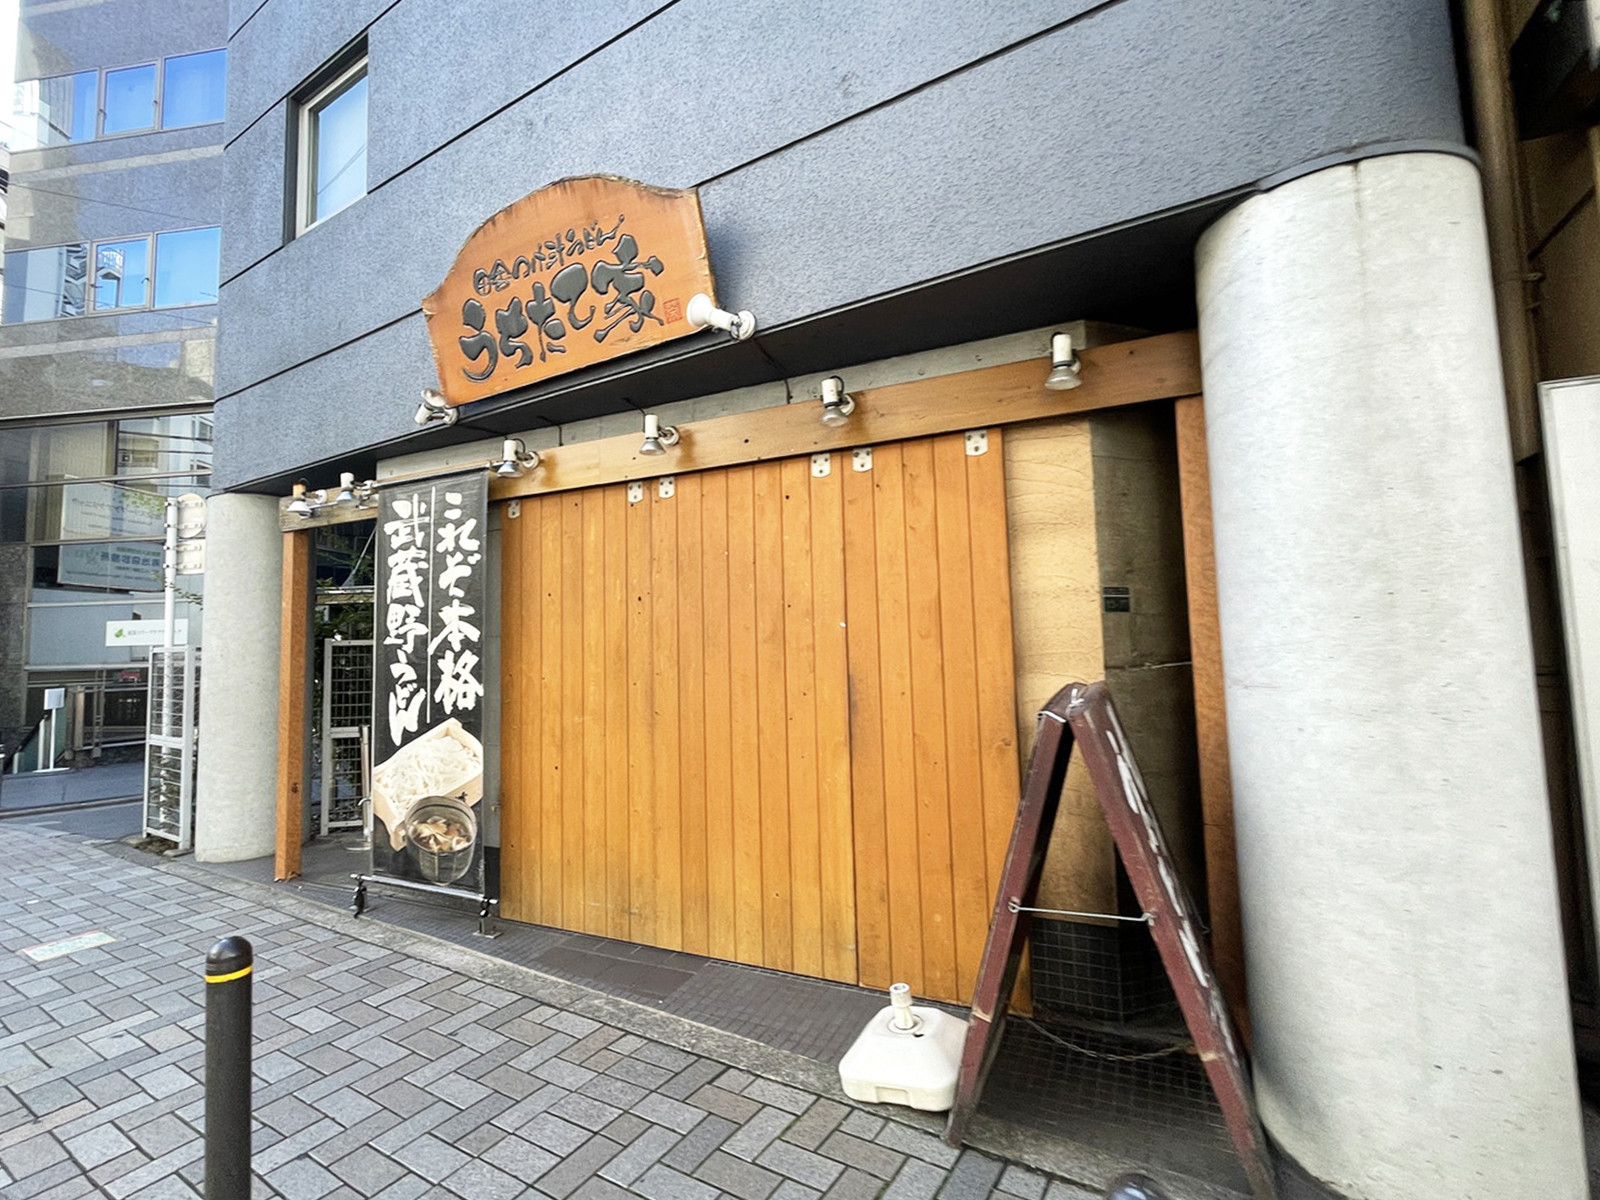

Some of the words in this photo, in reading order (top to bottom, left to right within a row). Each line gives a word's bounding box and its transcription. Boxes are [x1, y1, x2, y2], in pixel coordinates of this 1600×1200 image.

[383, 493, 429, 747] 武蔵野うどん
[428, 491, 484, 714] これぞ本格
